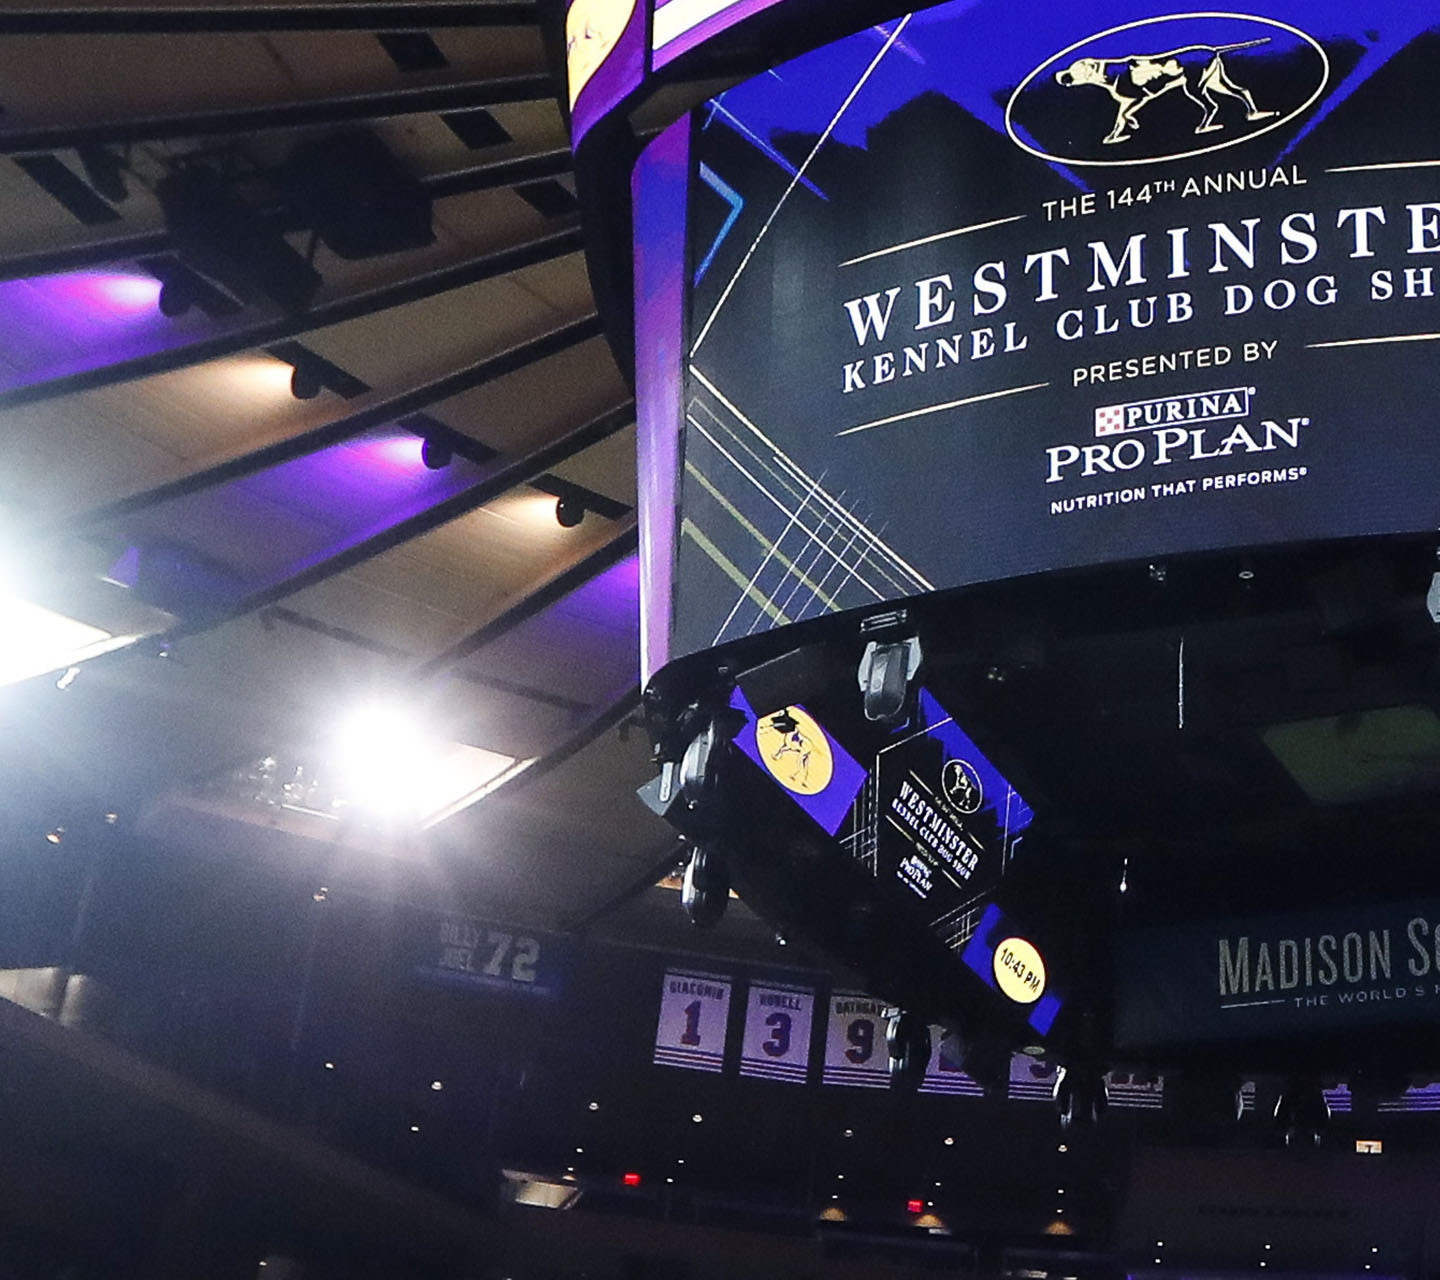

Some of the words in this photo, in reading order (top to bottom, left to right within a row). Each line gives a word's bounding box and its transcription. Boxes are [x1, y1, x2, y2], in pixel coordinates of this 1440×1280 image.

[1042, 194, 1097, 222] THE
[1107, 179, 1176, 211] 144TH
[1181, 163, 1308, 200] ANNUAL
[841, 325, 1028, 394] KENNEL
[1055, 290, 1195, 342] CLUB
[1222, 274, 1338, 317] DOG
[1073, 346, 1232, 387] PRESENTED
[1243, 340, 1278, 362] BY
[1127, 392, 1243, 427] PURINA
[1050, 486, 1146, 516] NUTRITION
[1151, 478, 1197, 498] THAT
[898, 780, 980, 872] WESTMINSTER
[482, 933, 540, 983] 72
[1000, 946, 1027, 979] 10:43
[1023, 969, 1042, 993] PM
[1218, 929, 1392, 997] MADISON
[680, 1000, 703, 1047] 1
[1293, 995, 1329, 1009] THE
[762, 1012, 793, 1058] 3
[845, 1018, 876, 1065] 9
